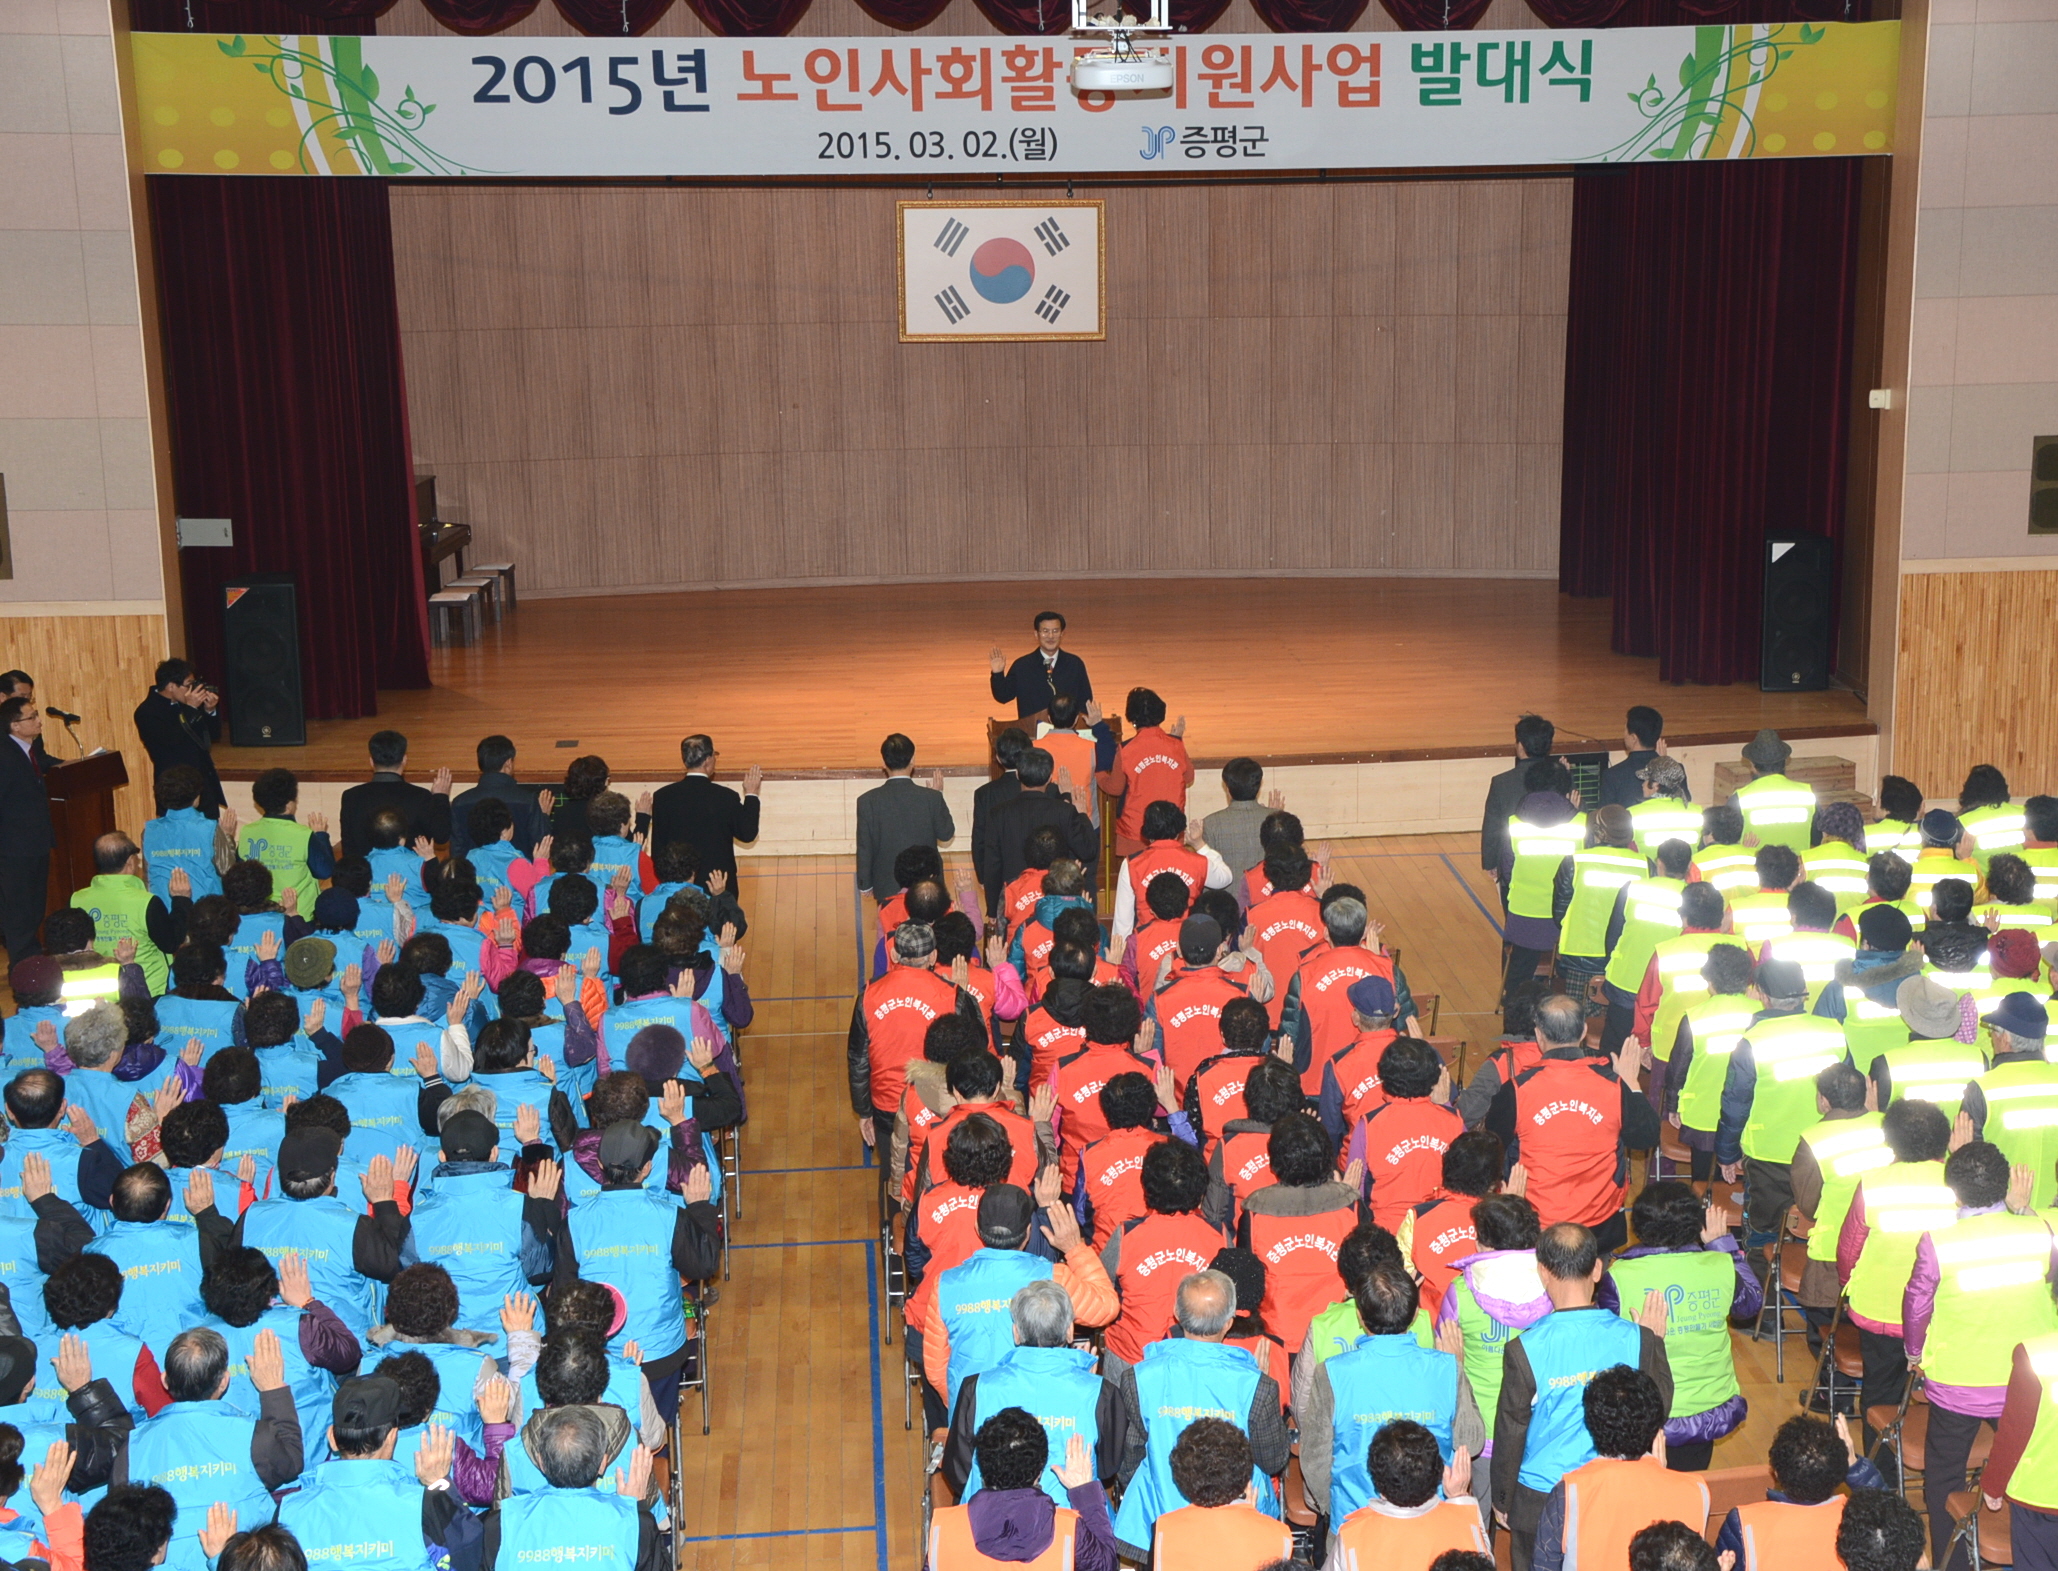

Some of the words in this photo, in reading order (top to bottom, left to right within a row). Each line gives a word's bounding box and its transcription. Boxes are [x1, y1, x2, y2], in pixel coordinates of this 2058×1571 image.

[471, 48, 711, 115] 2015년
[1411, 39, 1594, 106] 발대식
[1110, 74, 1144, 83] EPSON
[818, 131, 900, 161] 2015.
[908, 128, 954, 160] 03.
[1180, 126, 1269, 158] 증평군
[1134, 754, 1179, 774] 증평군노인복지관
[269, 845, 293, 858] 증평군
[1015, 890, 1045, 911] 증평군노
[103, 914, 129, 928] 증평군
[1260, 919, 1317, 942] 증평군노인복지관
[1149, 940, 1178, 961] 증평군노
[874, 996, 937, 1021] 증평군노인복지관
[1169, 1004, 1222, 1028] 증평군노인복
[1038, 1026, 1087, 1048] 증평군노인복
[1073, 1080, 1107, 1103] 증평군노
[1212, 1081, 1245, 1106] 증평군노
[1351, 1075, 1383, 1099] 증평군노
[1532, 1099, 1603, 1126] 증평군노인복지관
[1385, 1135, 1450, 1165] 증평군노인복지
[1100, 1156, 1144, 1186] 증평군노인
[1238, 1153, 1270, 1181] 증평군노
[931, 1195, 979, 1224] 증평군노인
[429, 1242, 503, 1256] 9988행복지키미
[1429, 1225, 1476, 1254] 증평군노인
[584, 1244, 659, 1259] 9988행복지키미
[121, 1258, 181, 1280] 8행복지키미
[955, 1298, 1014, 1315] 9988행복지
[1688, 1288, 1721, 1312] 증평군
[1548, 1371, 1598, 1390] 9988행
[34, 1387, 70, 1402] 9988행
[152, 1461, 237, 1483] 988행복지키미
[305, 1541, 394, 1561] 988행복지키미
[517, 1545, 614, 1564] 9988행복지키미
